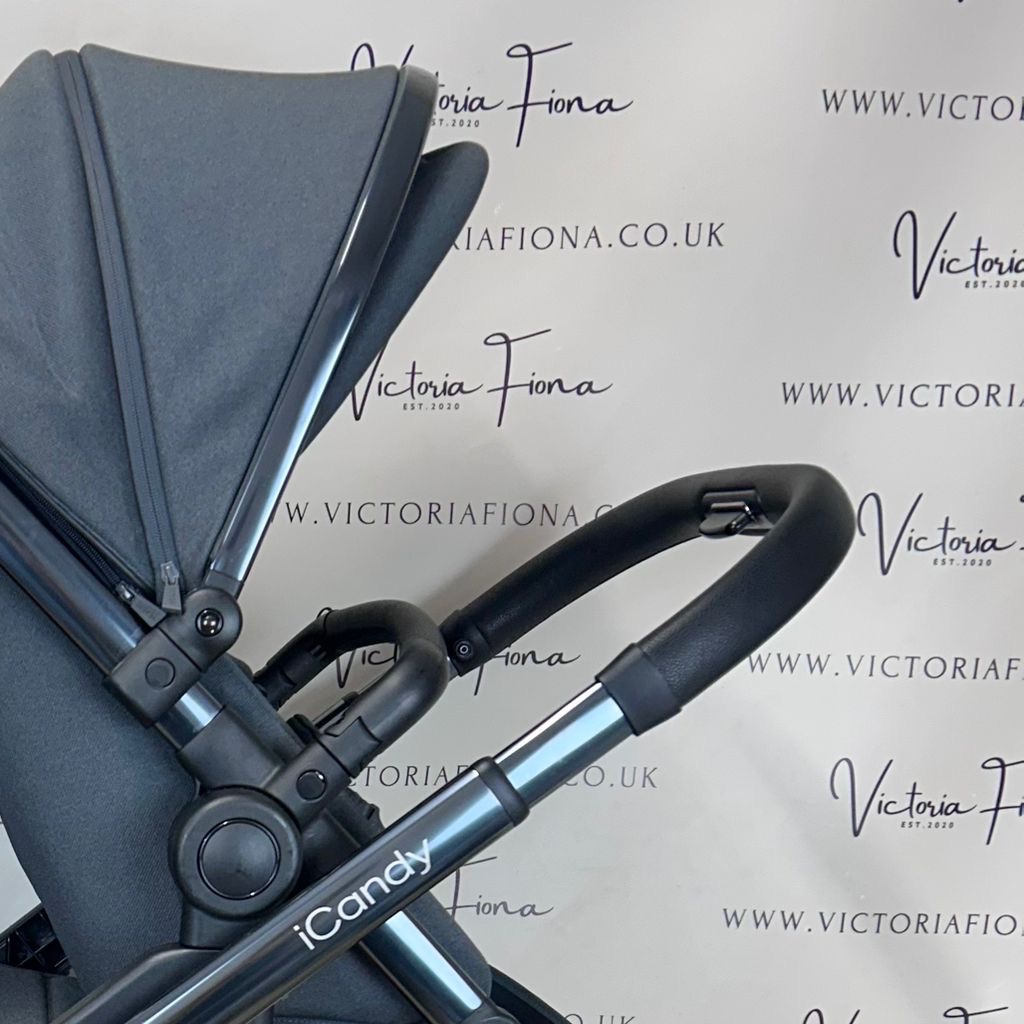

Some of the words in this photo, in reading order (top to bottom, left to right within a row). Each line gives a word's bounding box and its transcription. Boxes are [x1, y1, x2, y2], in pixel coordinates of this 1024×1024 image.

[506, 42, 634, 148] Fiona
[822, 89, 1024, 121] WWW.VICTO
[431, 118, 480, 127] ST.2020
[454, 222, 726, 251] IAFIONA.CO.UK
[351, 349, 483, 421] Victoria
[484, 328, 614, 428] Fiona
[402, 402, 460, 411] EST.2020
[781, 381, 1024, 408] WWW.VICTORI
[857, 491, 1017, 577] Victoria
[932, 557, 992, 567] EST.2020
[748, 652, 1024, 681] WWW.VICTORIAF
[830, 757, 977, 838] Victoria
[900, 820, 955, 830] EST.2020
[293, 838, 433, 951] iCandy
[722, 908, 1024, 936] WWW.VICTORIAFIO
